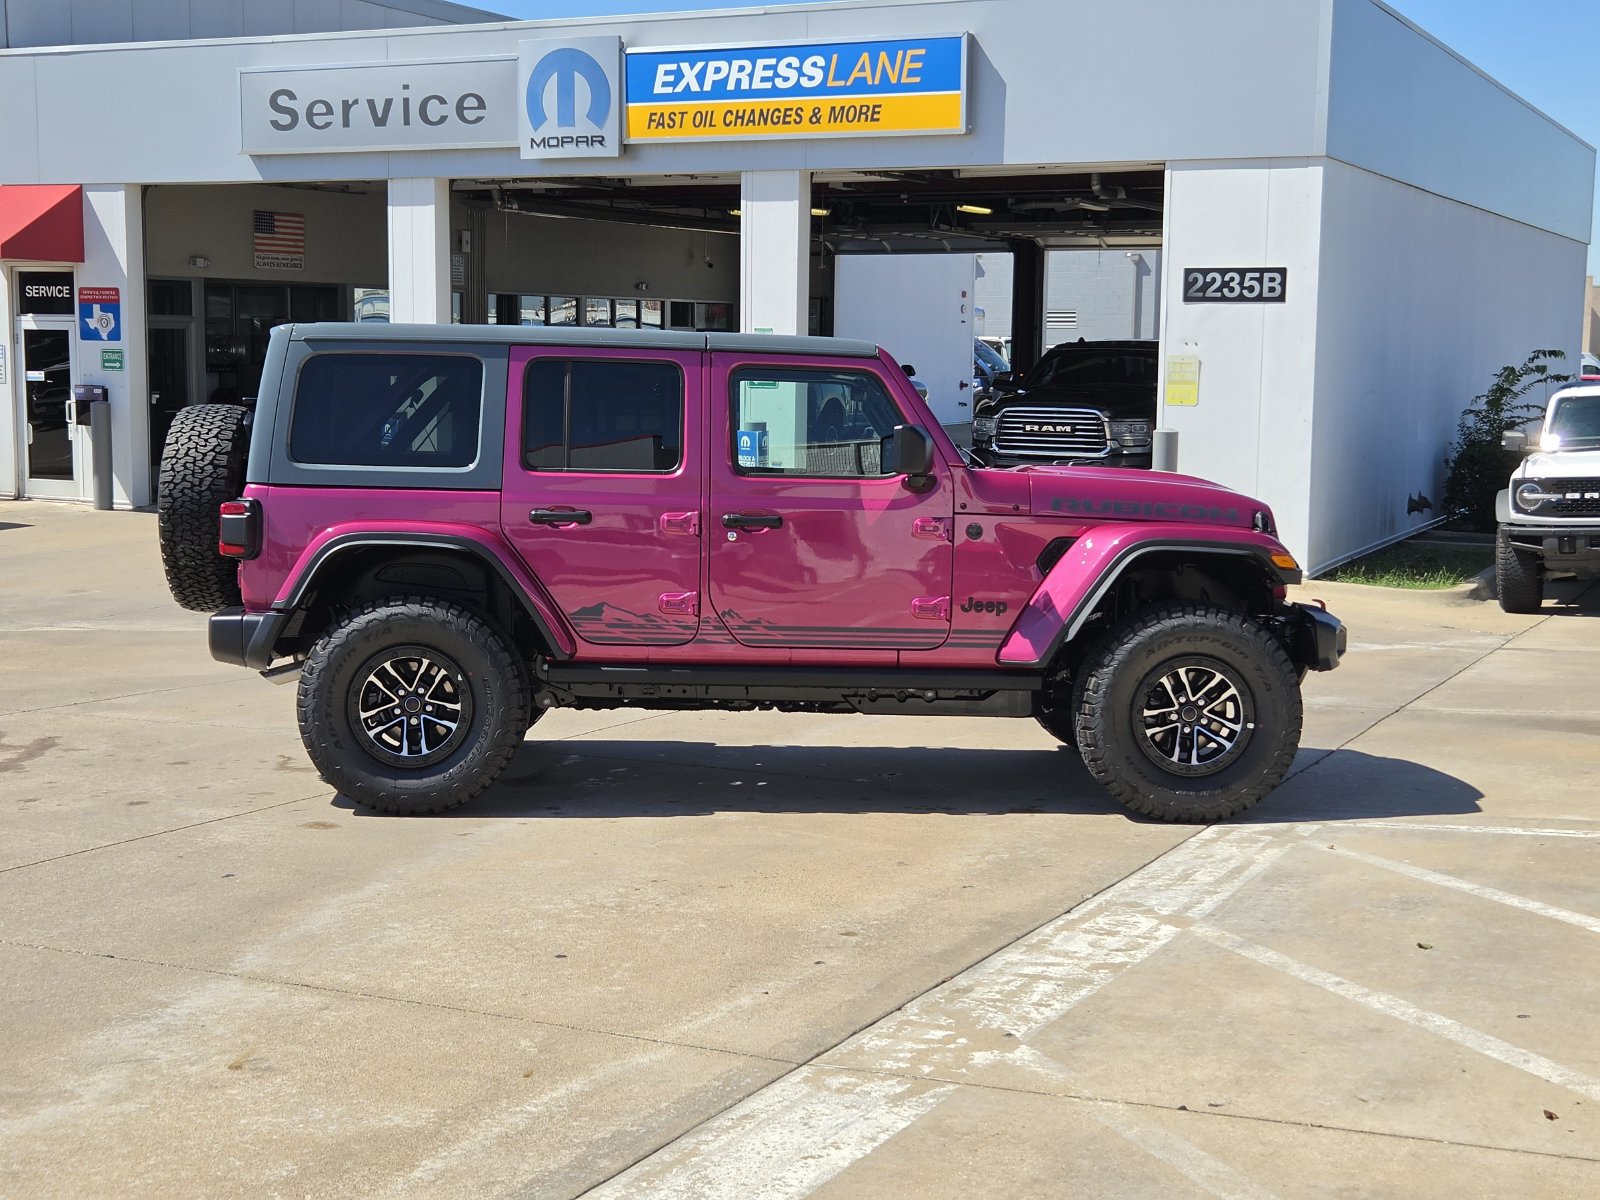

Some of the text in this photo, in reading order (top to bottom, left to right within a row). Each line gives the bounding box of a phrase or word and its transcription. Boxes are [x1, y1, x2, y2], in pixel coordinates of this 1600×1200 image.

[269, 84, 487, 132] Service
[647, 104, 882, 130] FAST OIL CHANGES & MORE
[530, 135, 606, 150] MOPAR
[25, 285, 71, 298] SERVICE
[1187, 271, 1283, 299] 2235B
[103, 352, 122, 360] ENTRANCE
[1025, 424, 1072, 433] RAM
[1051, 497, 1239, 522] RUBICON
[960, 596, 1008, 616] Jeep
